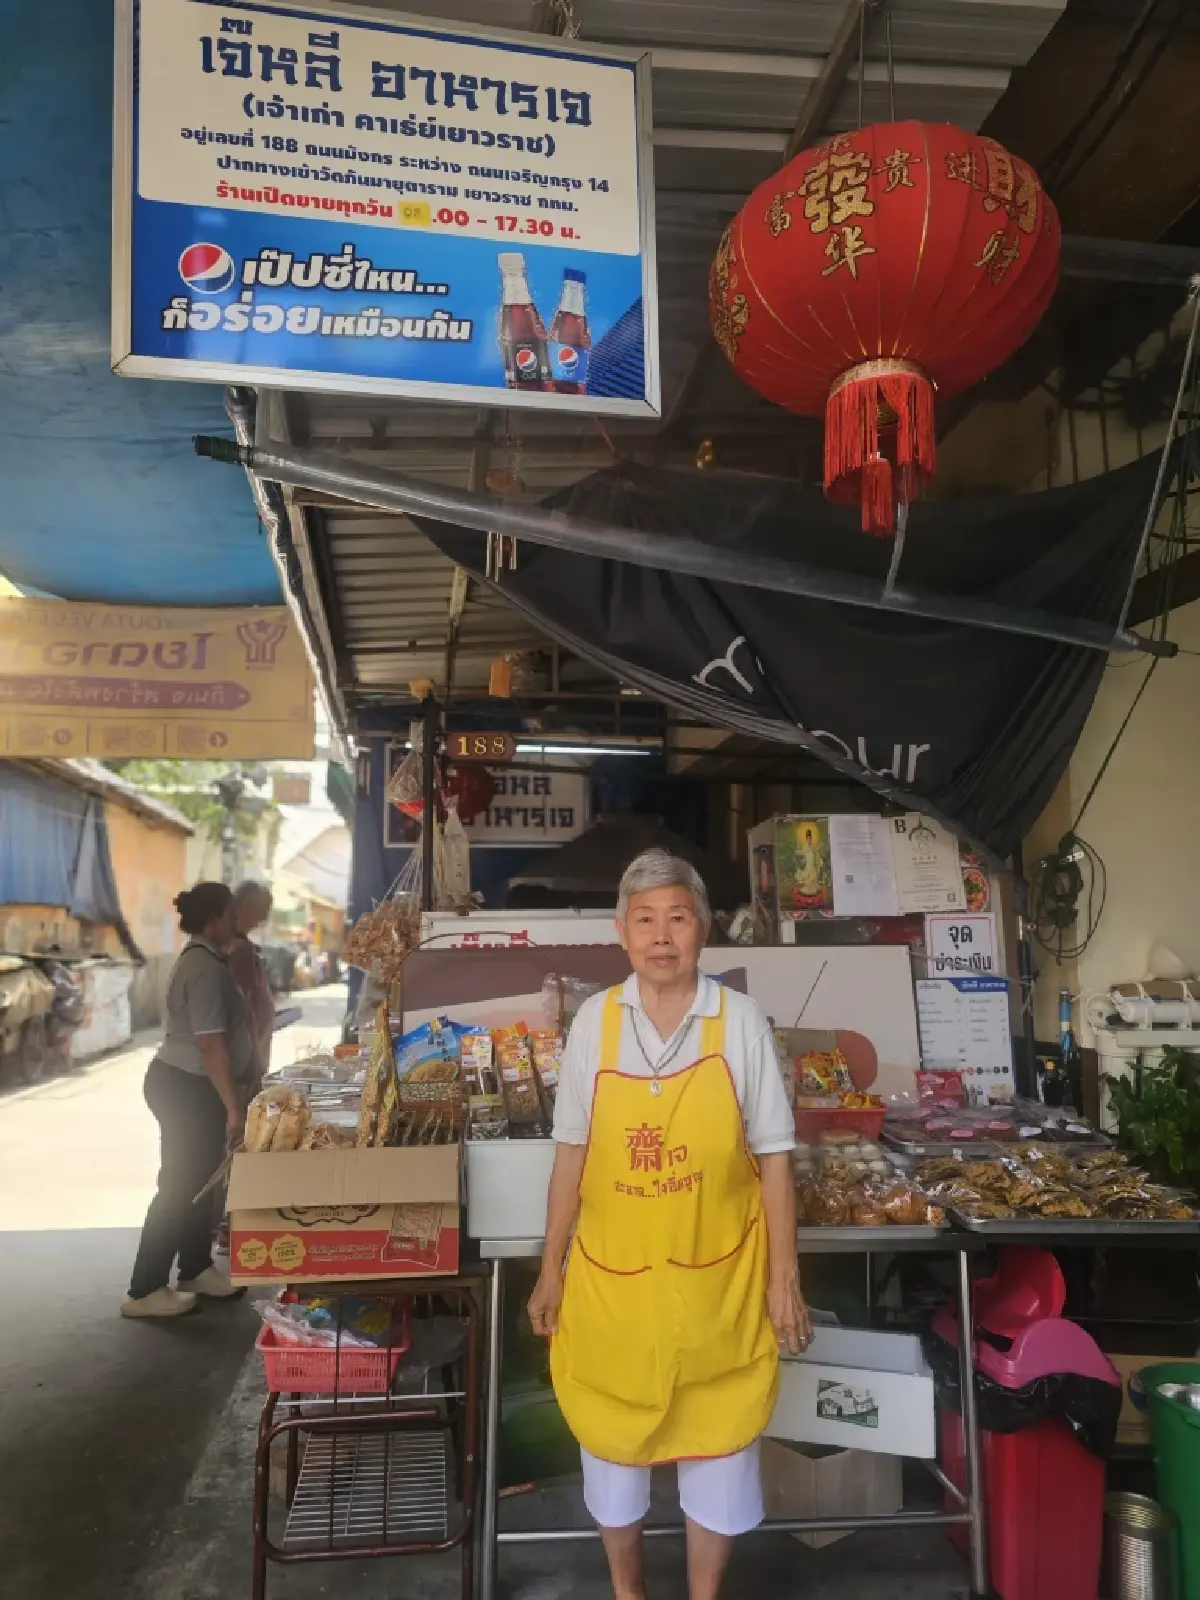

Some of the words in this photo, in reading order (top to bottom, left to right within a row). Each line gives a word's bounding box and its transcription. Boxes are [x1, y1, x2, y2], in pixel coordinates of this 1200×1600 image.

[199, 17, 342, 91] เจ๊หลี
[371, 61, 592, 127] อาหารเจ
[242, 92, 344, 127] (เจ้าเก่า
[181, 126, 254, 148] อยู่เลขที่
[261, 136, 298, 153] 188
[305, 144, 393, 166] ถนนมังกร
[400, 156, 461, 174] ระหว่าง
[468, 168, 583, 192] ถนนเจริญกรุง
[588, 177, 610, 192] 14
[217, 180, 393, 217] ร้านเปิดขายทุกวัน
[494, 216, 554, 236] 17.30
[560, 226, 581, 240] น.
[464, 188, 531, 207] เยาวราช
[537, 197, 579, 212] กทม.
[161, 289, 473, 341] ก็อร่อยเหมือนกัน
[457, 736, 506, 756] 188
[948, 925, 973, 950] จุด
